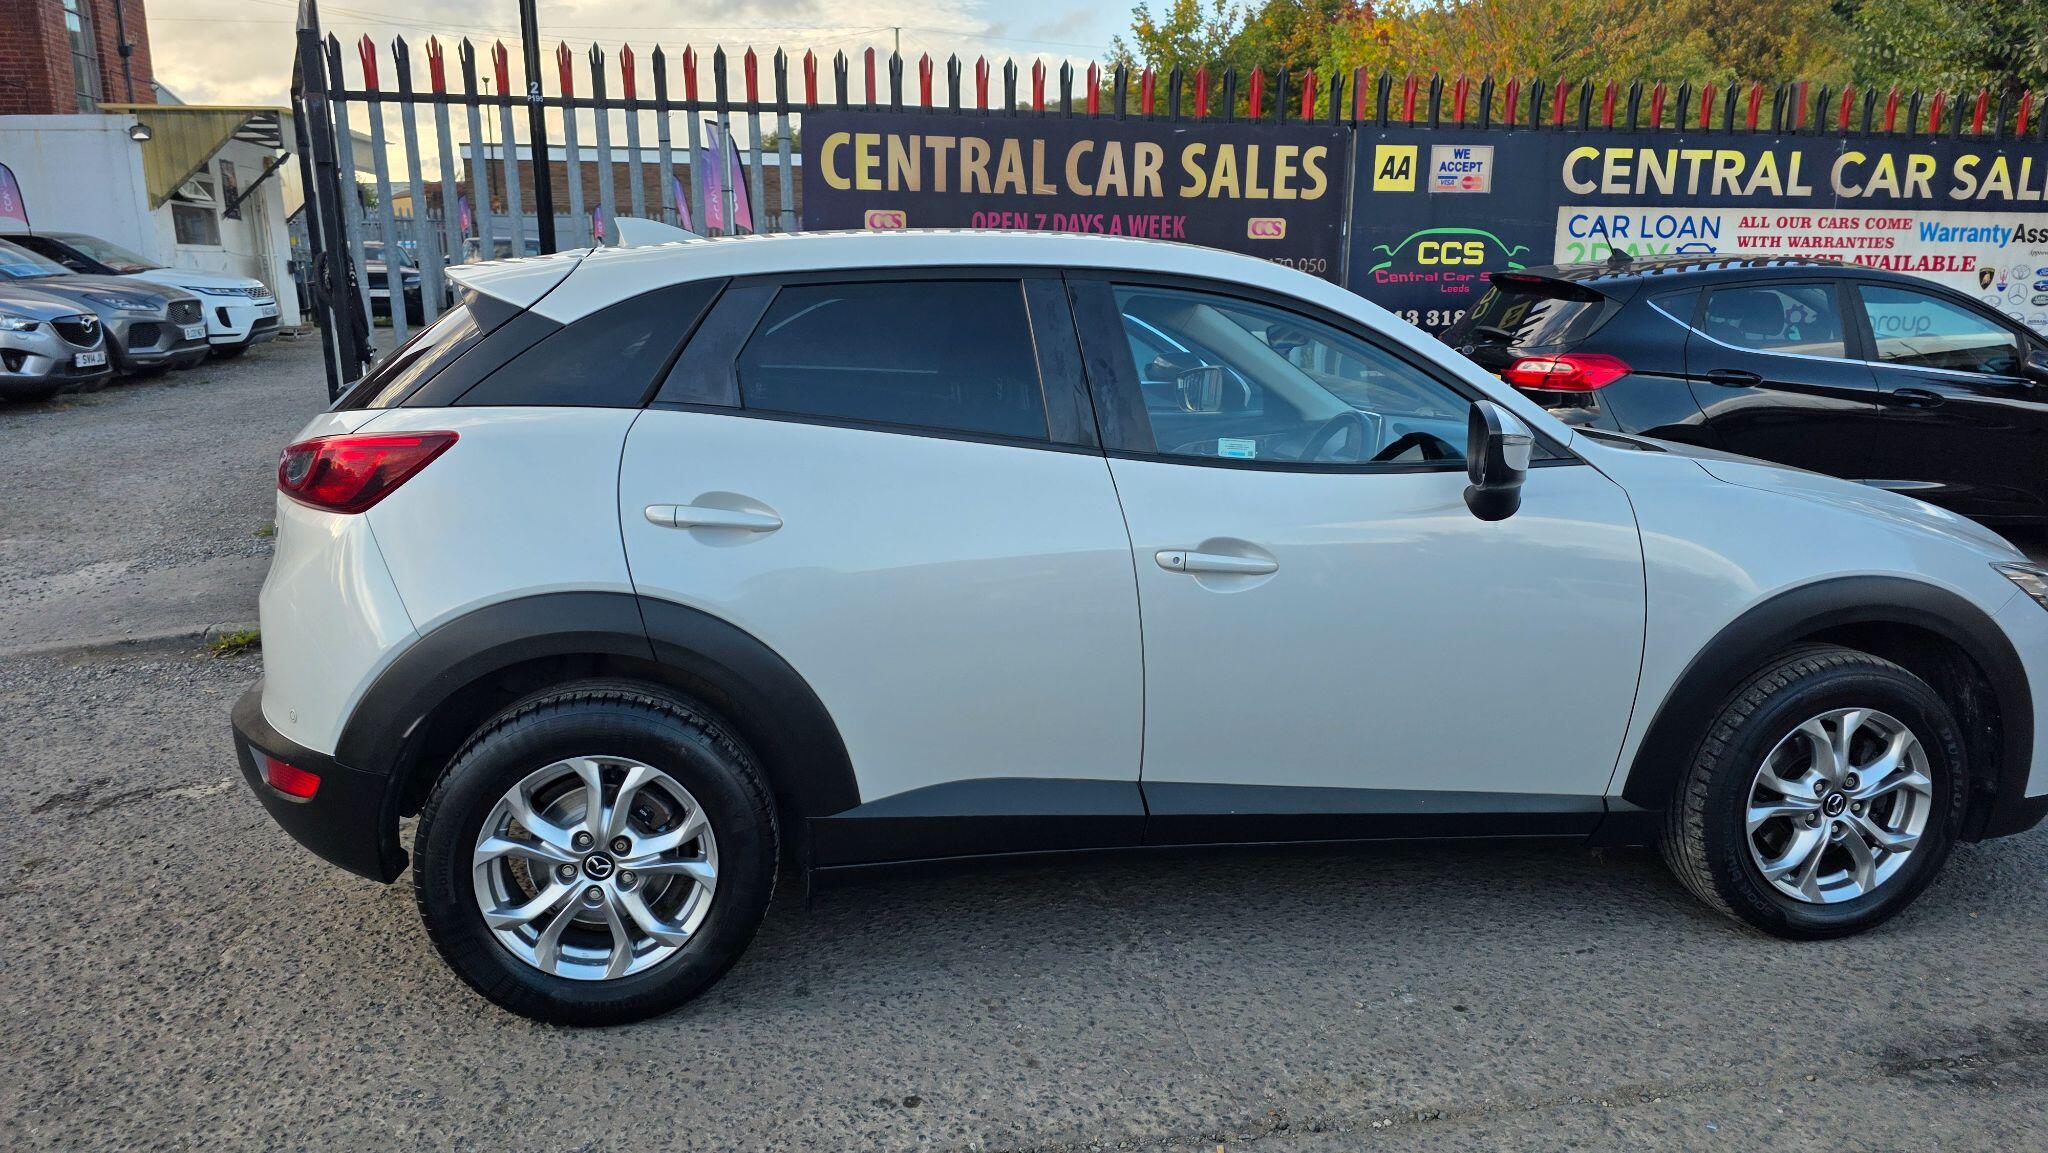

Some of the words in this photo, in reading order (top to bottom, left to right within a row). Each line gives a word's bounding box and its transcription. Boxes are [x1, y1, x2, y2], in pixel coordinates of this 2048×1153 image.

[530, 81, 539, 93] 2
[1453, 148, 1471, 159] WE
[820, 131, 1058, 195] CENTRAL
[1065, 139, 1165, 198] CAR
[1179, 142, 1328, 200] SALES
[1378, 155, 1411, 180] AA
[1439, 161, 1483, 173] ACCEPT
[1562, 146, 1813, 197] CENTRAL
[1831, 151, 1937, 199] CAR
[971, 211, 1028, 230] OPEN
[1034, 213, 1046, 230] 7
[1053, 213, 1104, 233] DAYS
[1109, 214, 1122, 236] A
[1127, 214, 1187, 239] WEEK
[1568, 214, 1630, 239] CAR
[1640, 214, 1721, 239] LOAN
[1738, 216, 1770, 229] ALL
[1776, 216, 1812, 229] OUR
[1817, 217, 1860, 230] CARS
[1864, 217, 1913, 230] COME
[1737, 235, 1782, 248] WITH
[1787, 236, 1895, 249] WARRANTIES
[1417, 240, 1485, 265] CCS
[1298, 257, 1327, 273] 050
[1853, 254, 1977, 272] AVAILABLE
[1375, 269, 1438, 284] Central
[1443, 272, 1475, 282] Car
[1441, 284, 1470, 293] Leeds
